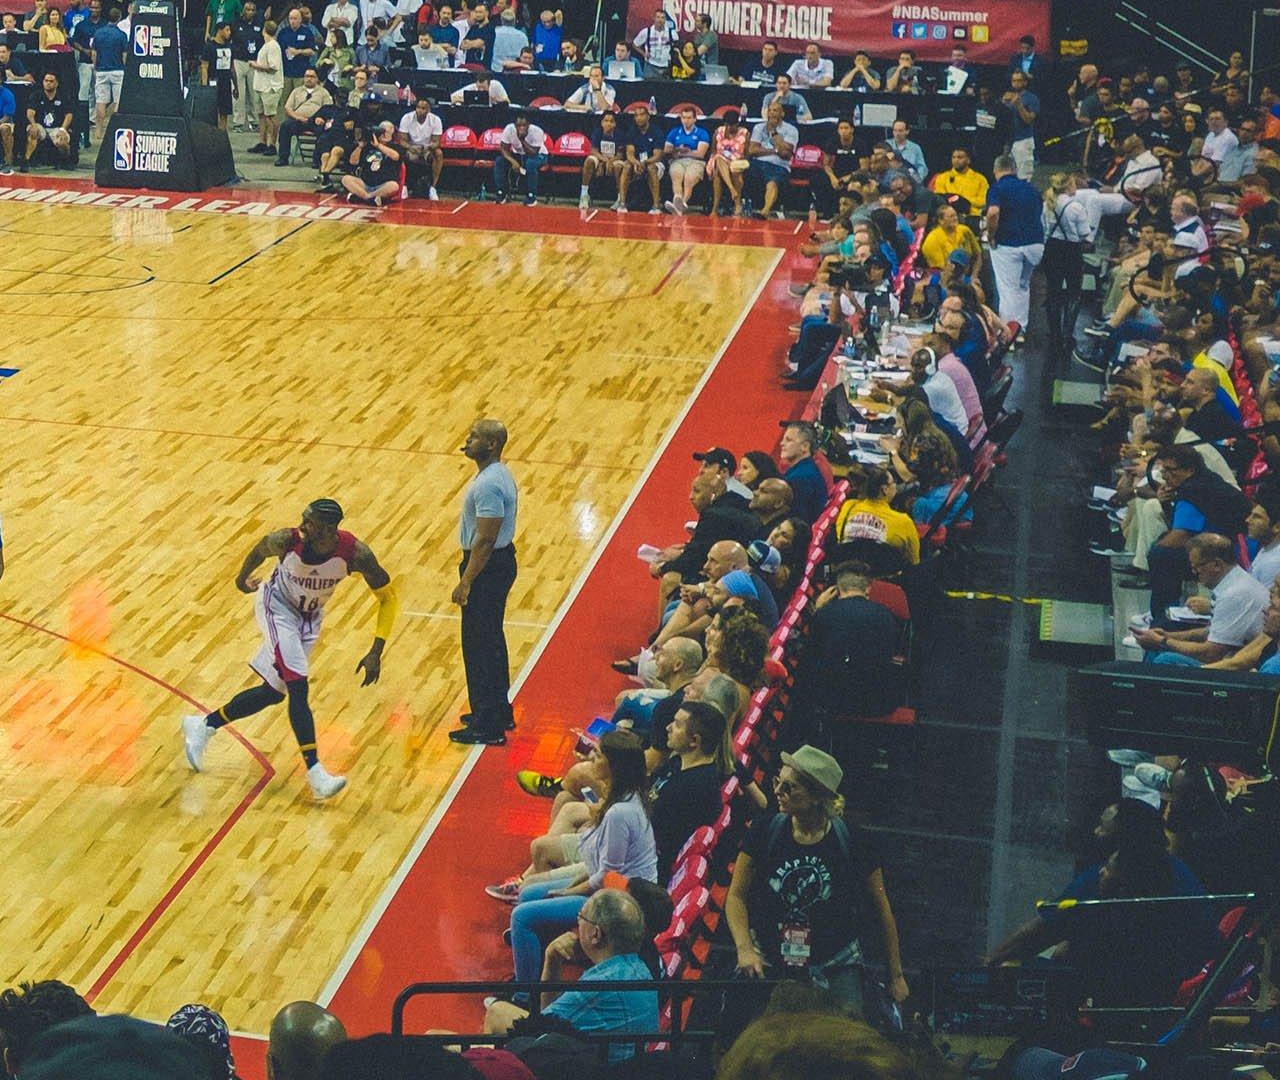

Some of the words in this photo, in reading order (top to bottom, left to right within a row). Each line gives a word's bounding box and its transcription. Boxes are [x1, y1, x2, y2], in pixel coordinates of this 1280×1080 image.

[765, 2, 833, 41] LEAGUE
[892, 4, 989, 23] #NBASummer
[139, 63, 164, 79] @NBA
[135, 134, 177, 157] SUMMER
[135, 152, 171, 173] LEAGUE
[172, 197, 384, 224] LEAGUE
